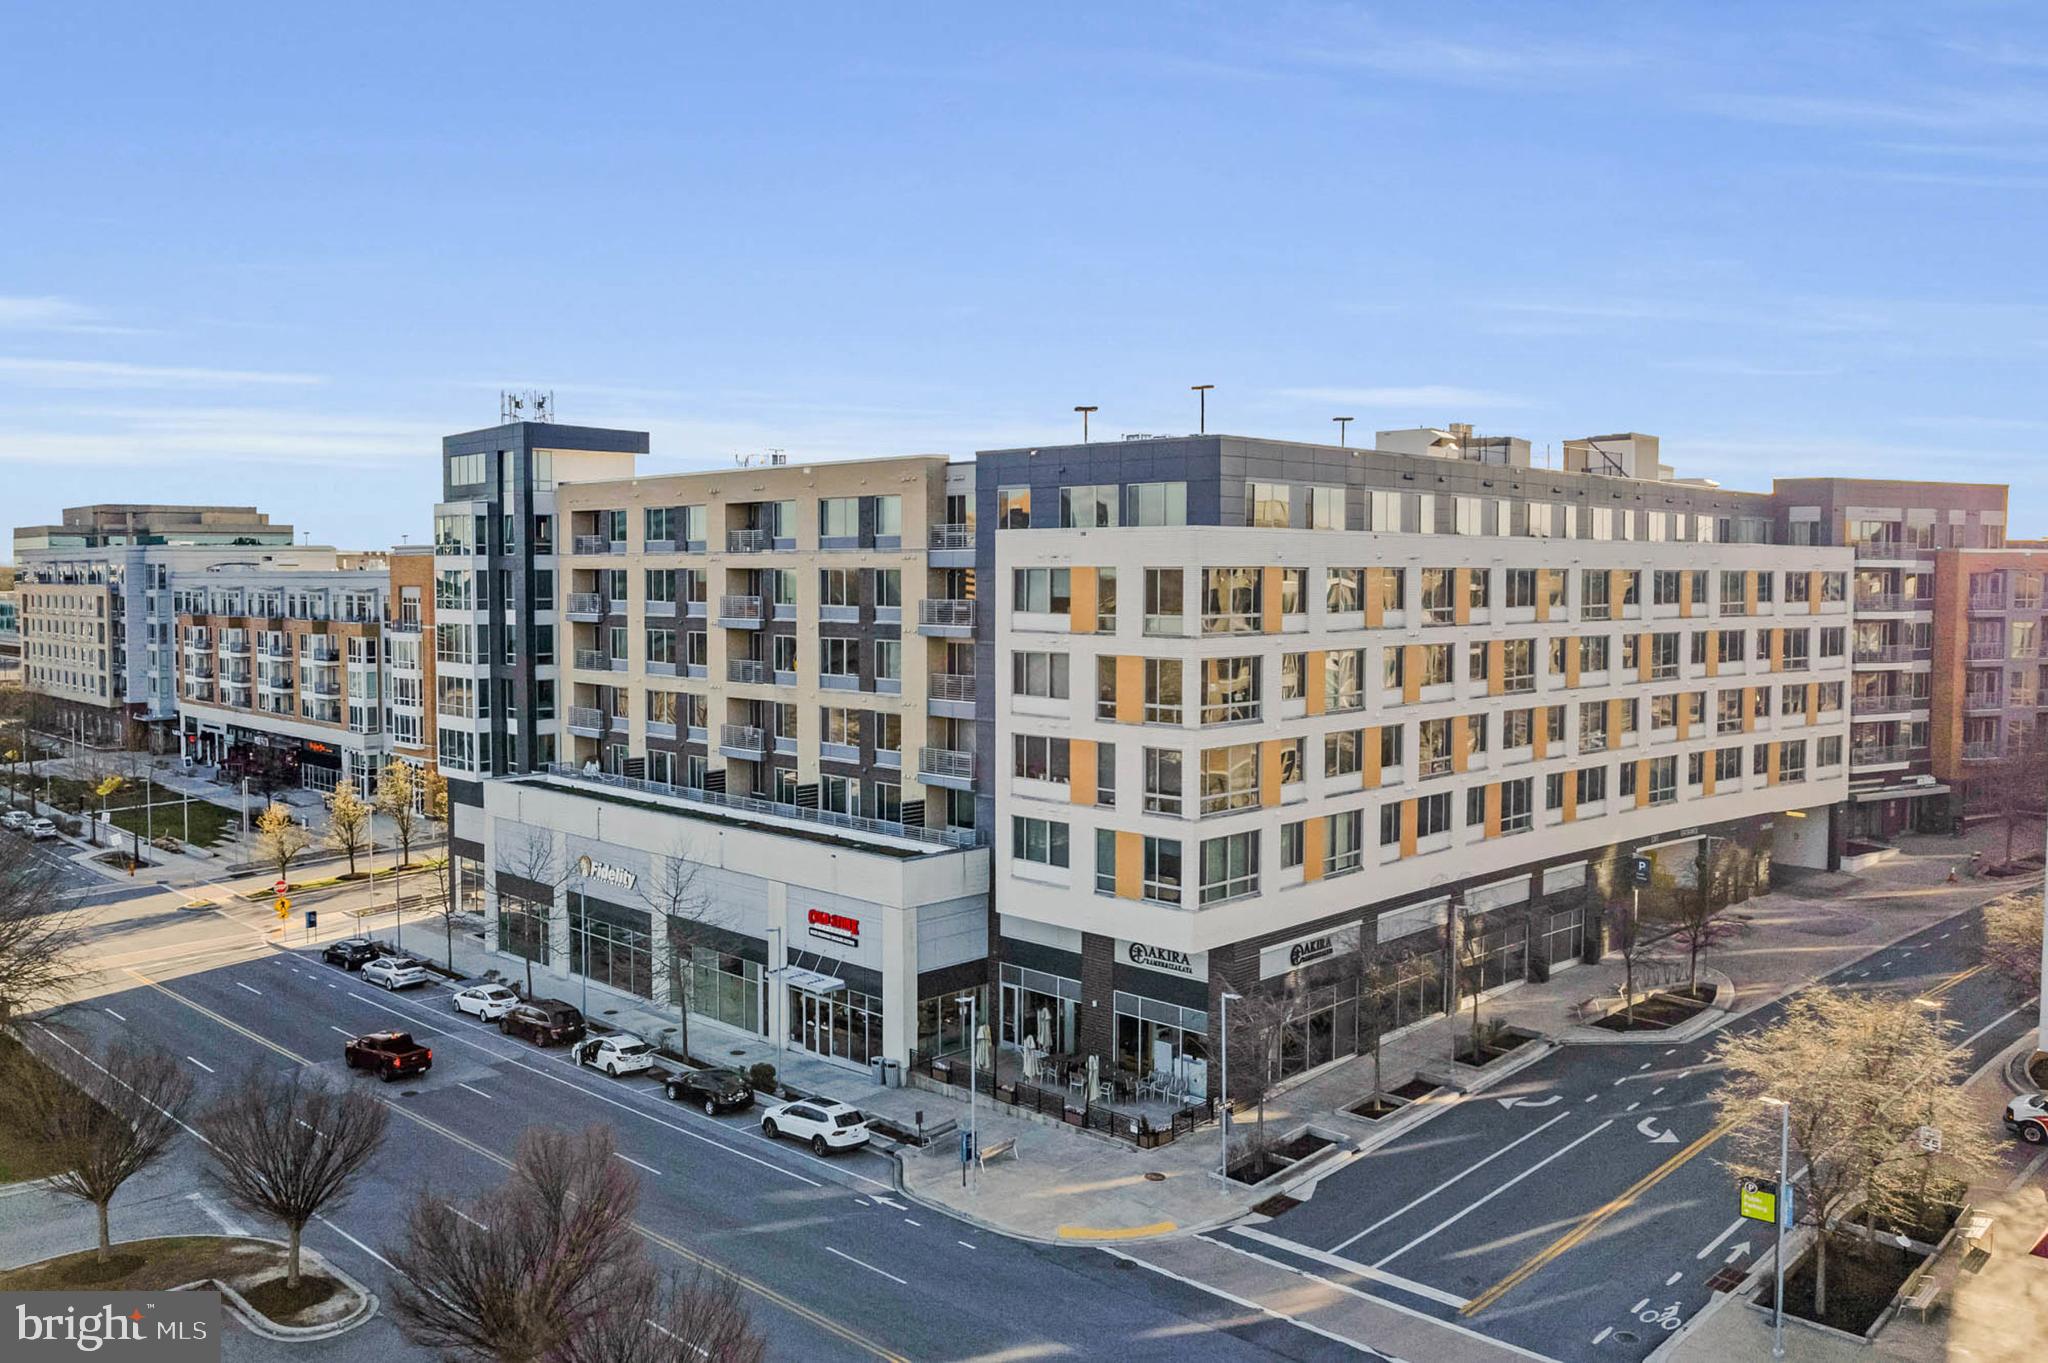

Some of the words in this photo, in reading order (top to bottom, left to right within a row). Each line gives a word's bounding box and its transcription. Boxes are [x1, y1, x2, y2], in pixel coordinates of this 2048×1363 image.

[590, 860, 637, 890] Fidelity
[1638, 861, 1647, 871] P
[1303, 936, 1333, 955] AKIRA
[1148, 946, 1191, 966] AKIRA
